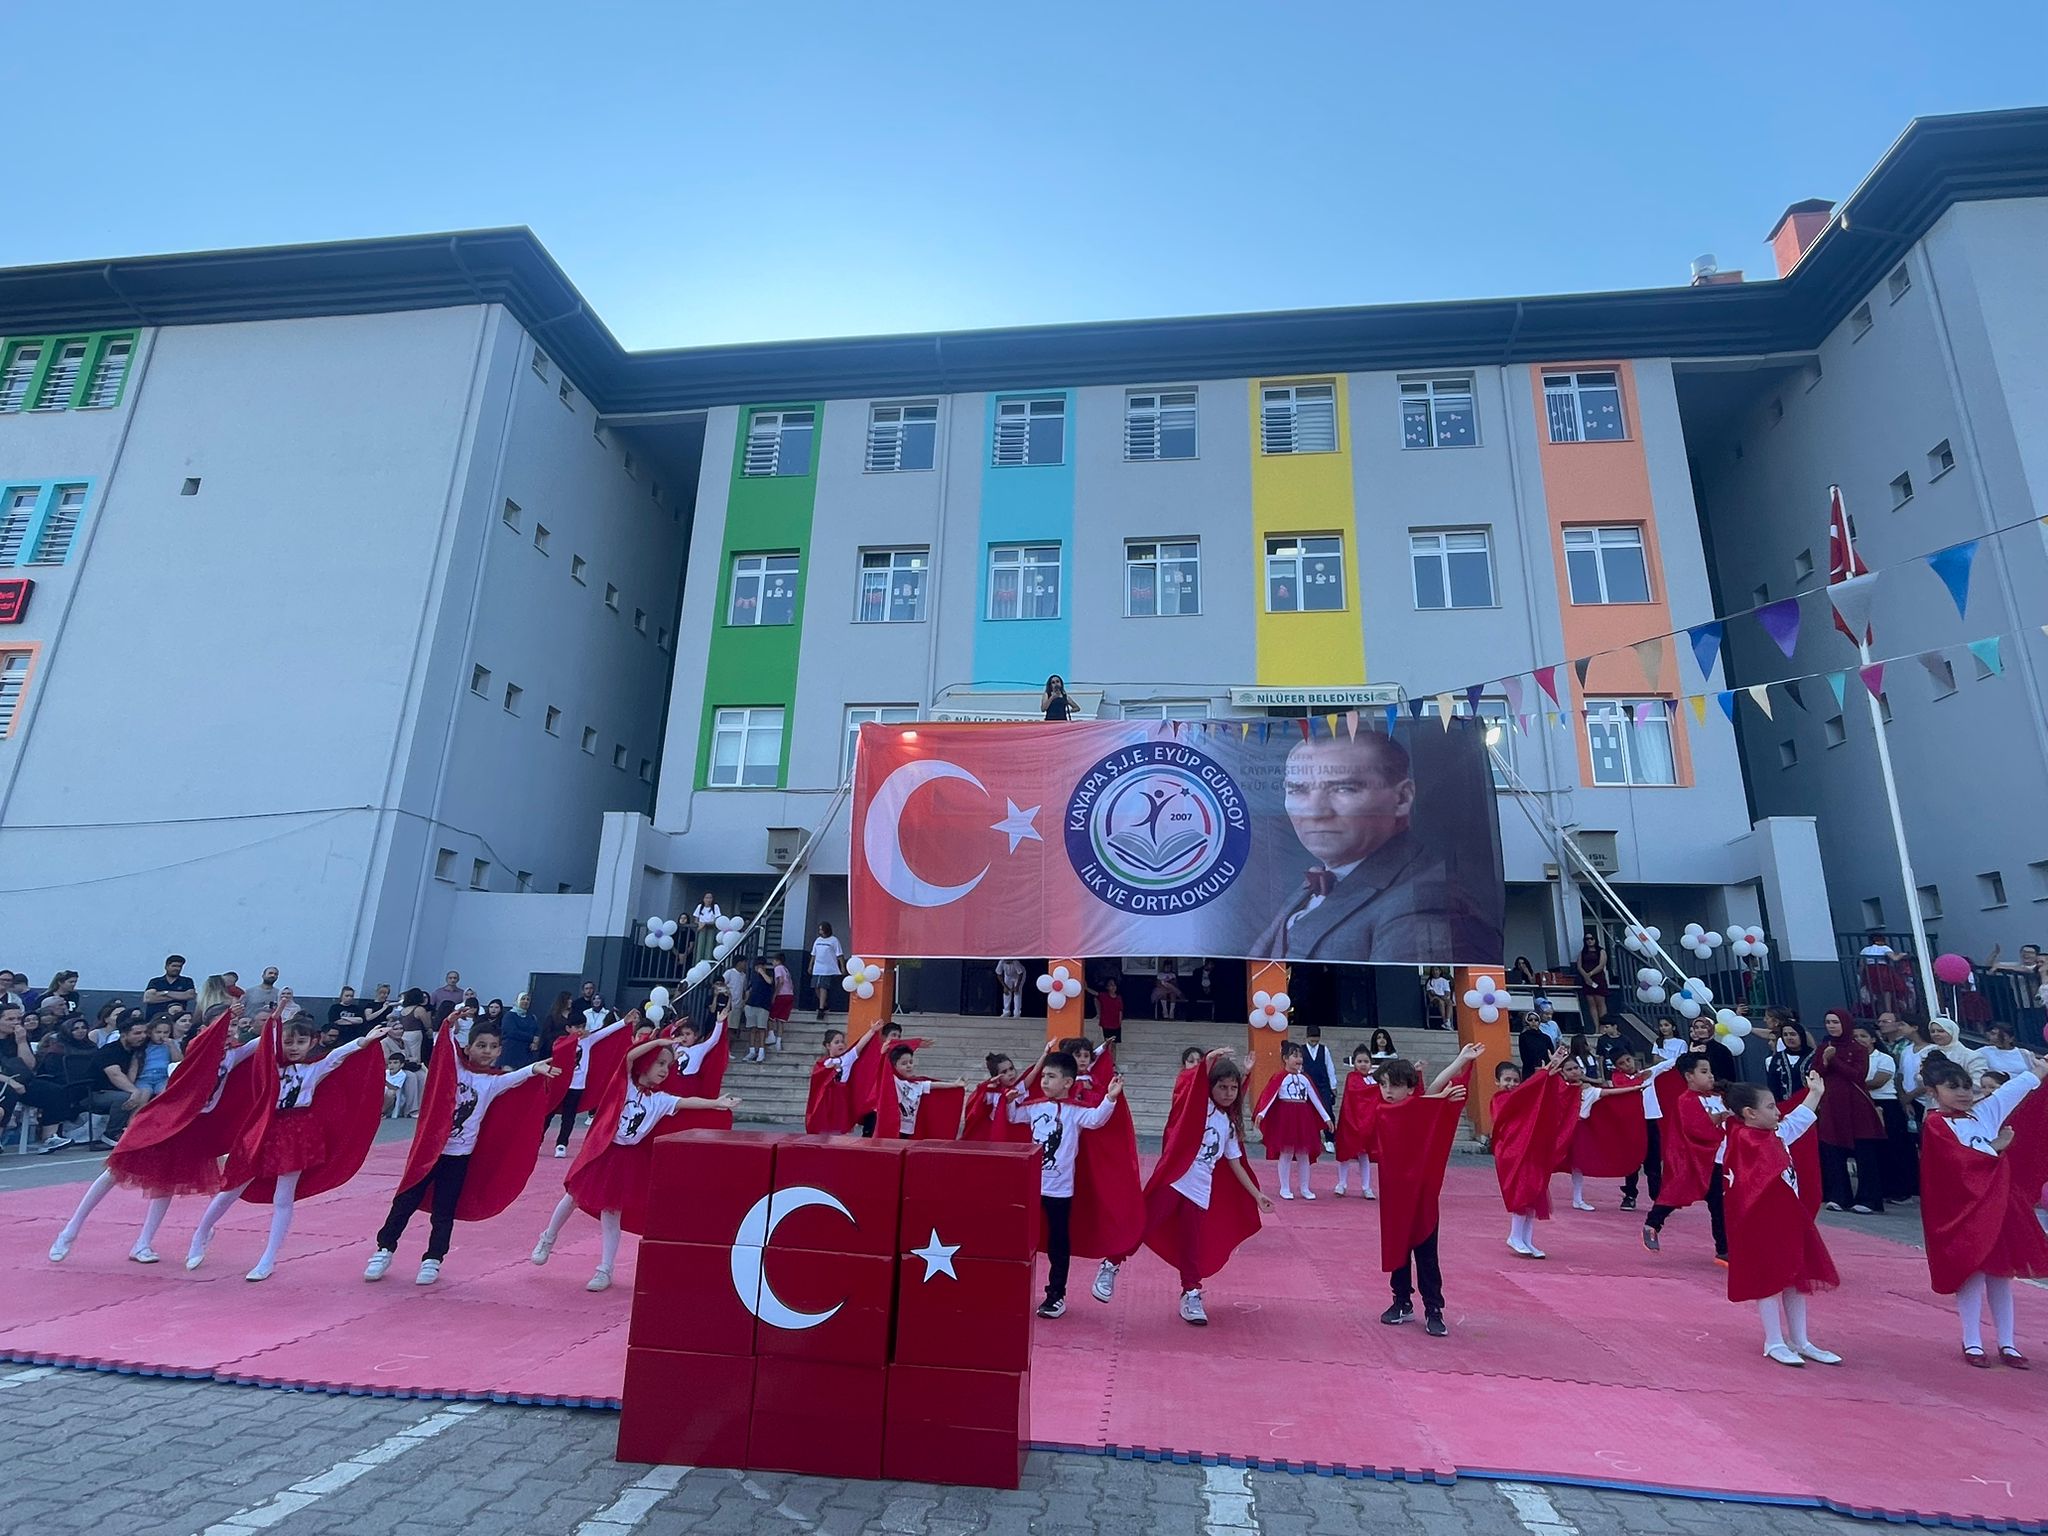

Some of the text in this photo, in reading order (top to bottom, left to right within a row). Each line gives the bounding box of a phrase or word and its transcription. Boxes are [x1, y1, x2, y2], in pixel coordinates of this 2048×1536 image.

[1257, 691, 1375, 703] NİLÜFER BELEDİYESİ
[1070, 746, 1245, 831] KAYAPA Ş.J.E. EYÜP GÜRSOY
[1170, 813, 1192, 822] 2007
[1080, 861, 1236, 911] İLK VE ORTAOKULU
[68, 1000, 77, 1012] P
